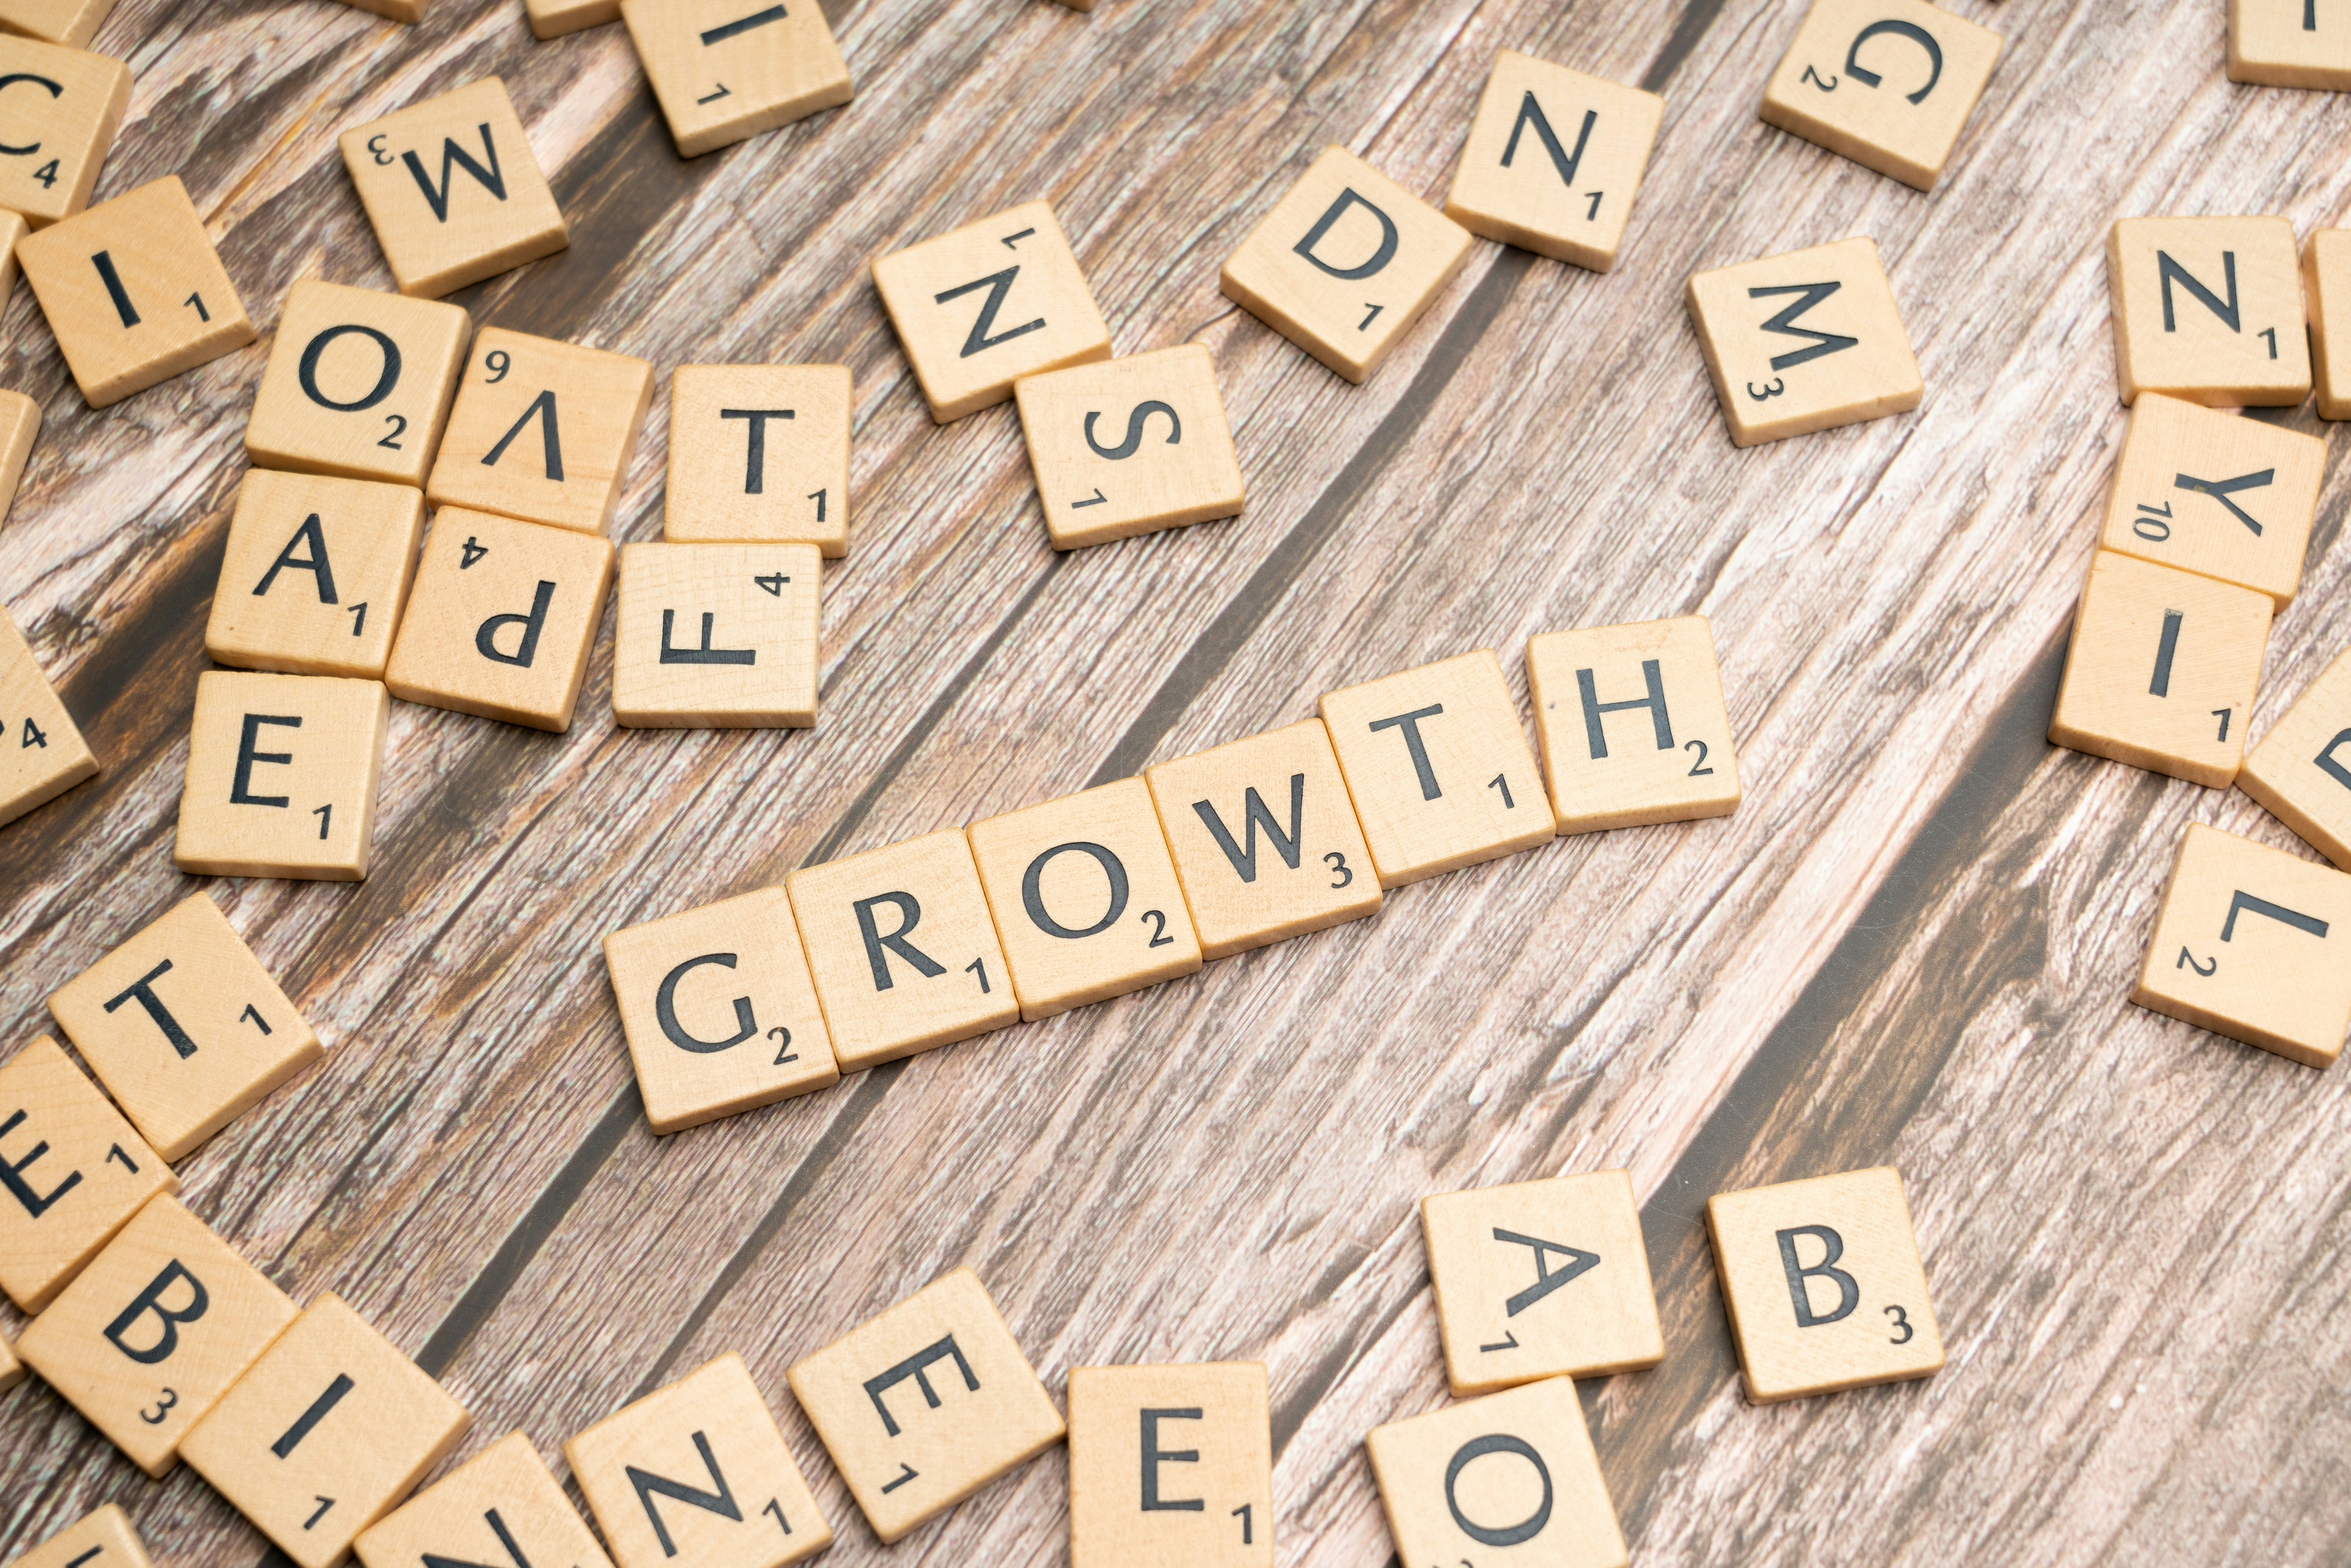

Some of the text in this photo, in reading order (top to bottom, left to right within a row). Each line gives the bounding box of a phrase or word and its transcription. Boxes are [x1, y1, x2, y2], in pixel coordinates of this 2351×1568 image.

[697, 83, 731, 105] 1
[1801, 19, 1943, 105] G 2
[33, 159, 60, 189] 4
[1500, 90, 1603, 221] N 1
[91, 250, 210, 329] I 1
[1001, 228, 1035, 250] 1
[1292, 187, 1399, 332] D 1
[2157, 250, 2278, 360] N 1
[298, 324, 407, 450] O 2
[720, 409, 827, 523] T 1
[1071, 400, 1182, 509] S 1
[2133, 468, 2275, 542] Y 10
[252, 513, 367, 637] A 1
[460, 536, 557, 668] P 4
[659, 571, 791, 666] F 4
[2149, 610, 2232, 743] I 1
[22, 717, 47, 749] 4
[229, 713, 332, 840] E 1
[1684, 740, 1714, 777] 2
[1487, 773, 1515, 809] 1
[655, 658, 1675, 1054] GROWTH
[1323, 851, 1353, 889] 3
[965, 957, 991, 994] 1
[1141, 910, 1174, 948] 2
[2176, 890, 2330, 977] L 2
[103, 958, 272, 1060] T 1
[767, 1027, 799, 1065] 2
[106, 1143, 139, 1174] 1
[1480, 1227, 1601, 1353] A 1
[1775, 1224, 1914, 1345] B 3
[103, 1258, 209, 1425] B 3
[862, 1333, 981, 1495] E 1
[303, 1496, 335, 1530] 1
[625, 1430, 744, 1558] N
[762, 1498, 792, 1535] 1
[1140, 1407, 1252, 1544] E 1
[1444, 1433, 1553, 1547] O
